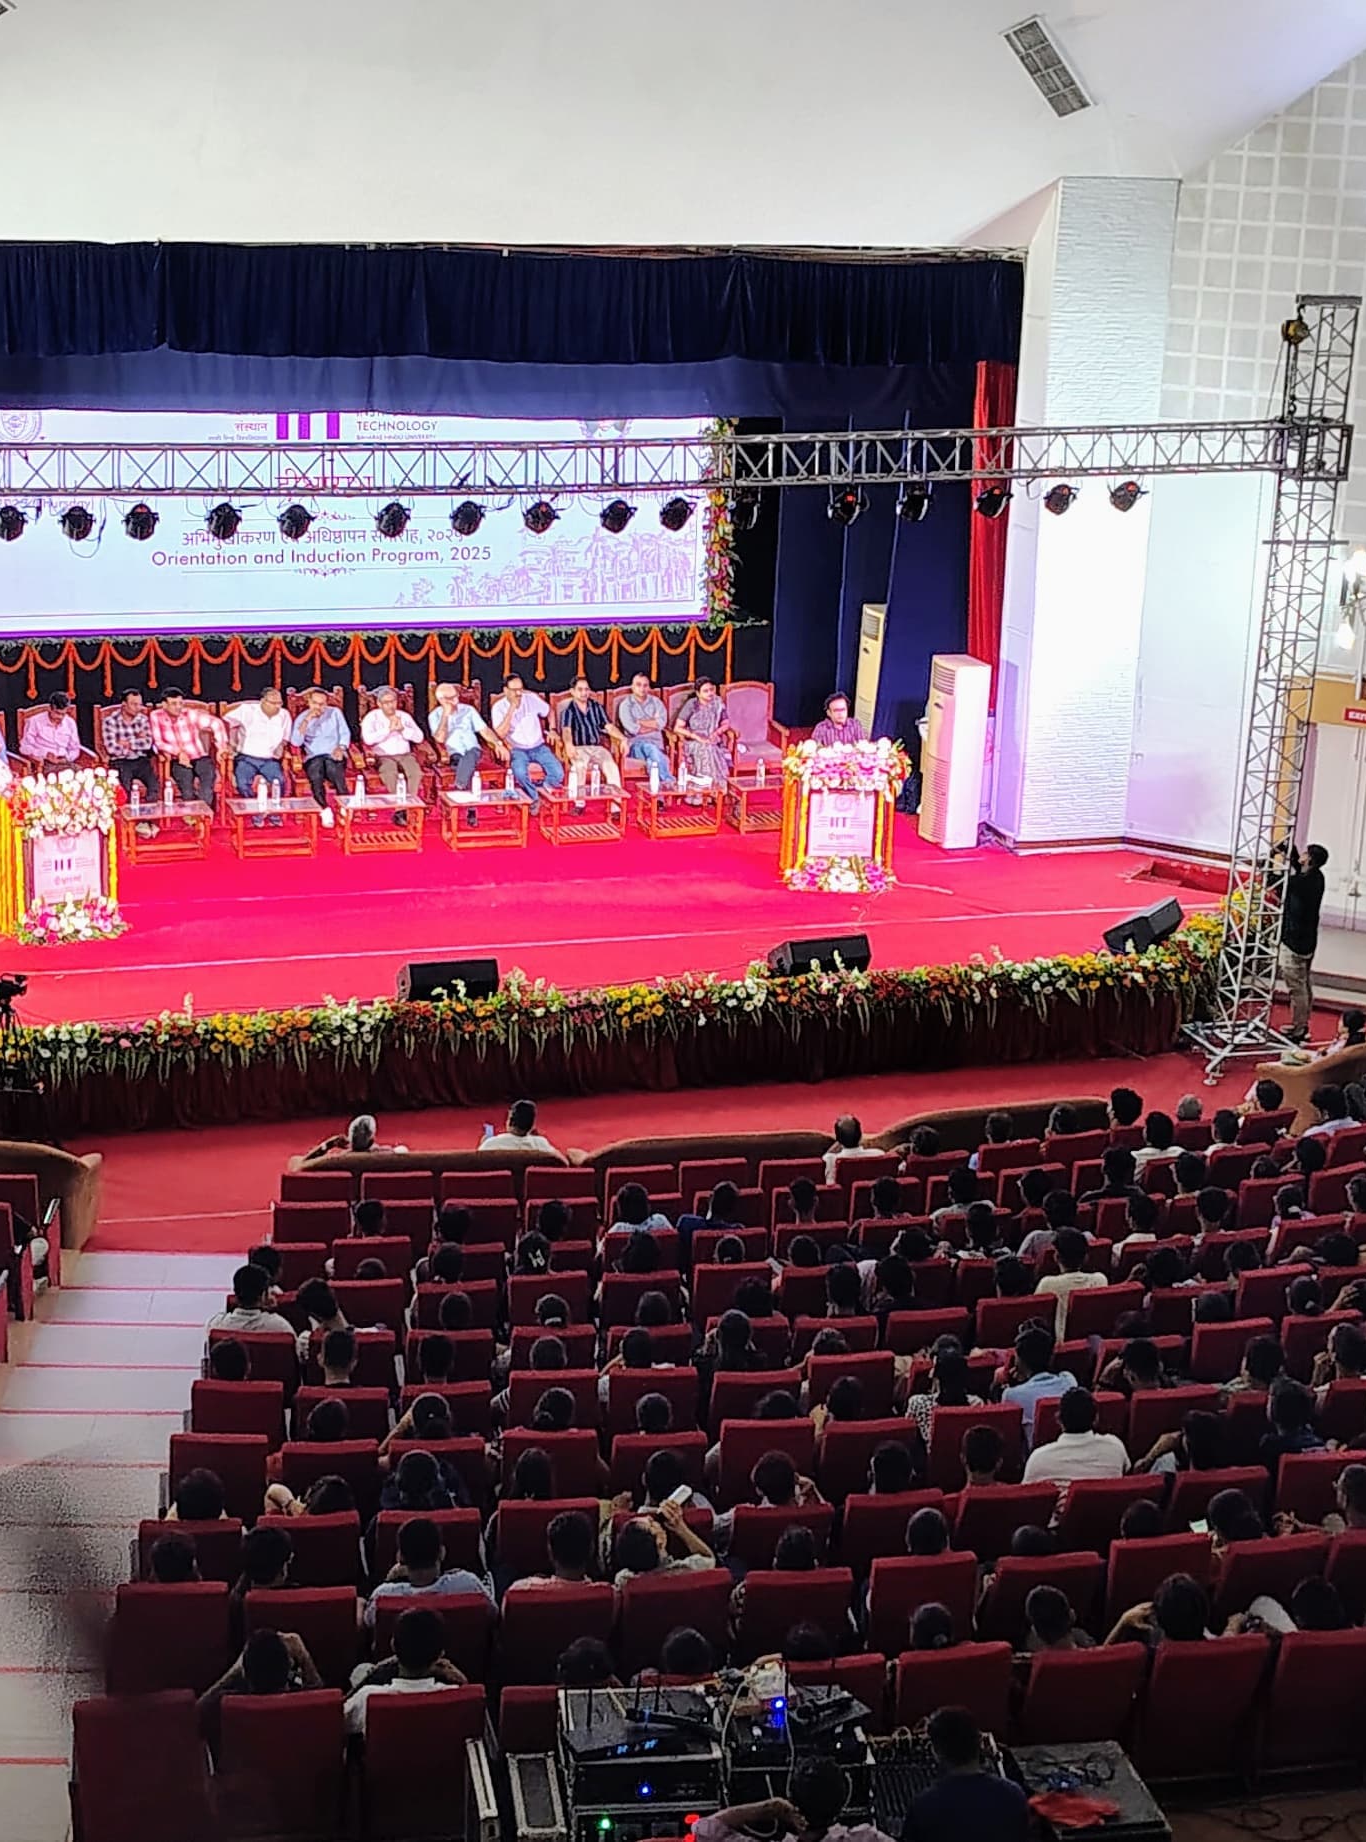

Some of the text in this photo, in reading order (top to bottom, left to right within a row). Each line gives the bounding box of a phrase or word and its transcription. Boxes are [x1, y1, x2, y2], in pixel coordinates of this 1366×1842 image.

[356, 420, 438, 431] TECHNOLOGY
[151, 546, 491, 566] Orientation and Induction Program, 2025
